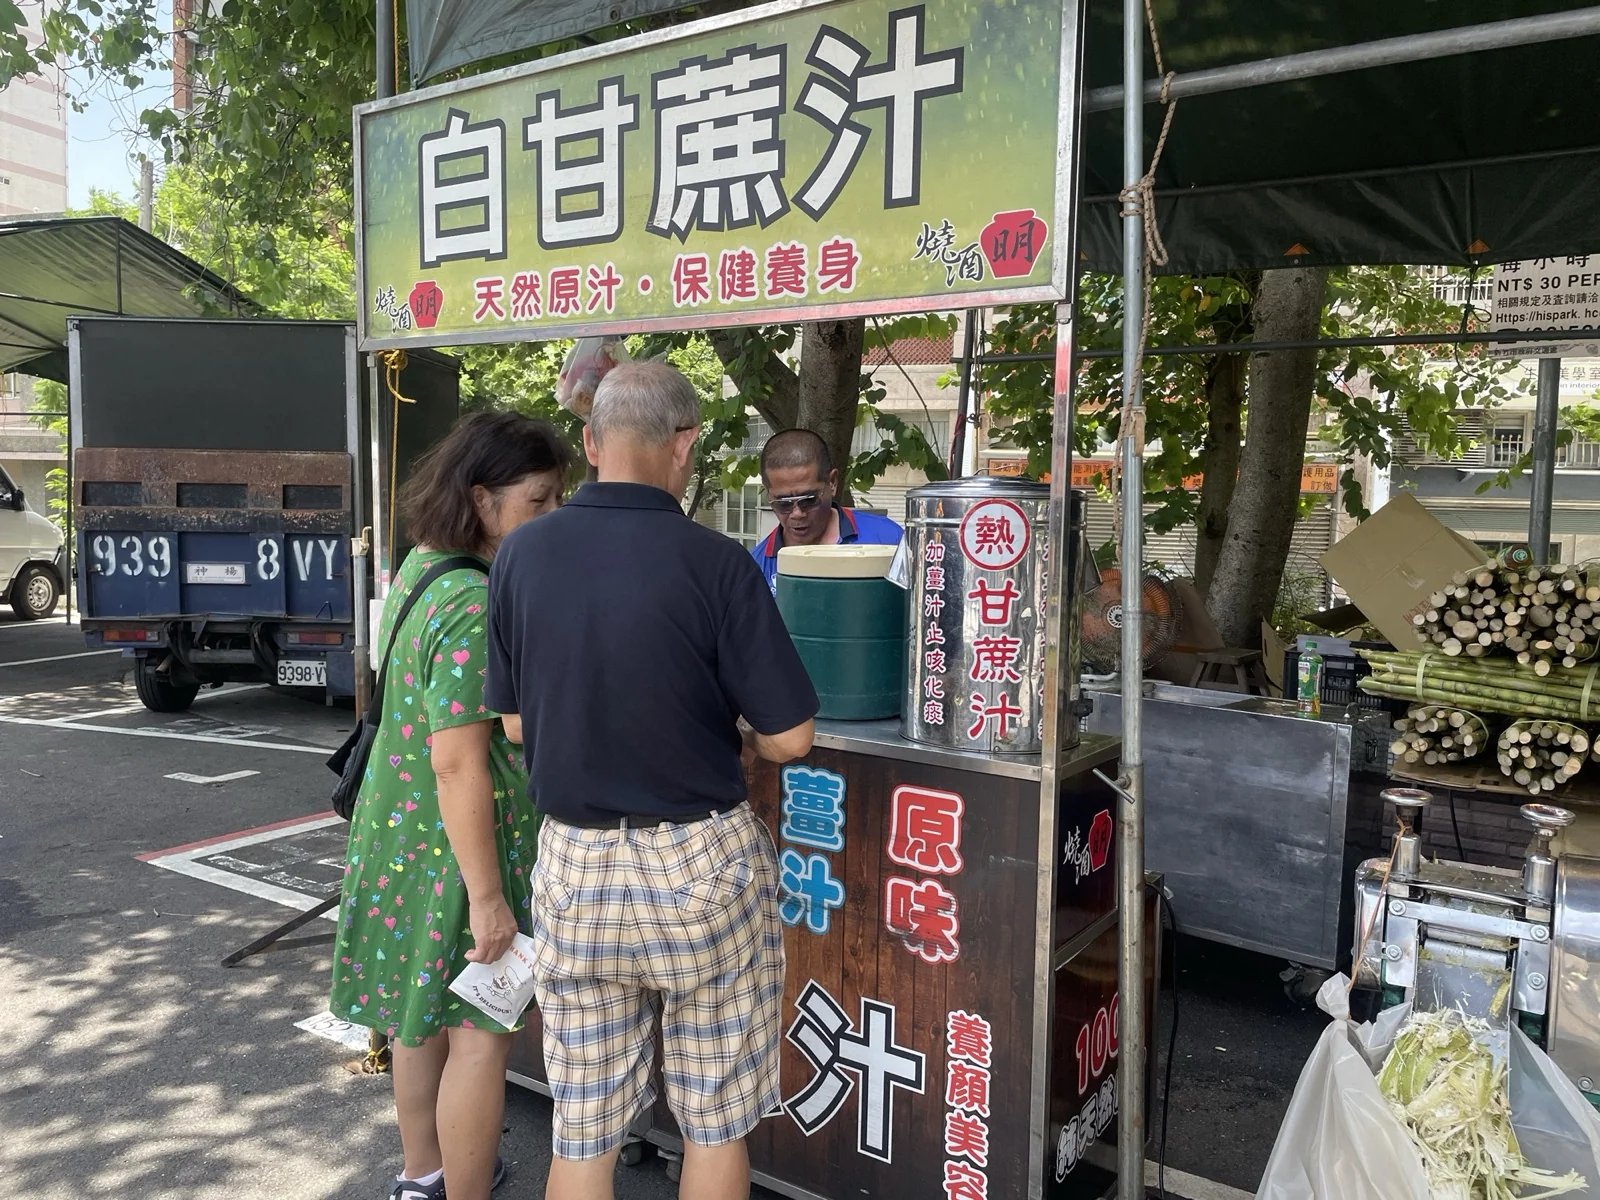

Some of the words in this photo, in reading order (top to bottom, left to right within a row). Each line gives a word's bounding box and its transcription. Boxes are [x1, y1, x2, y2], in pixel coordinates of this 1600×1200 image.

[419, 4, 964, 269] 白甘蔗汁
[1497, 292, 1599, 308] 相關規定及查詢請洽
[1498, 278, 1533, 292] NT$
[1540, 276, 1561, 289] 30
[1585, 308, 1600, 318] hc
[93, 535, 171, 578] 939
[974, 515, 1015, 555] 熱
[279, 666, 326, 682] 9398-V
[924, 542, 945, 725] 加薑汁止咳化痰
[968, 578, 1023, 740] 甘蔗汁
[780, 765, 846, 935] 薑汁
[884, 784, 965, 964] 原味
[761, 979, 926, 1164] 汁
[943, 1010, 992, 1200] 養顏美容
[1056, 1070, 1119, 1183] 純天然
